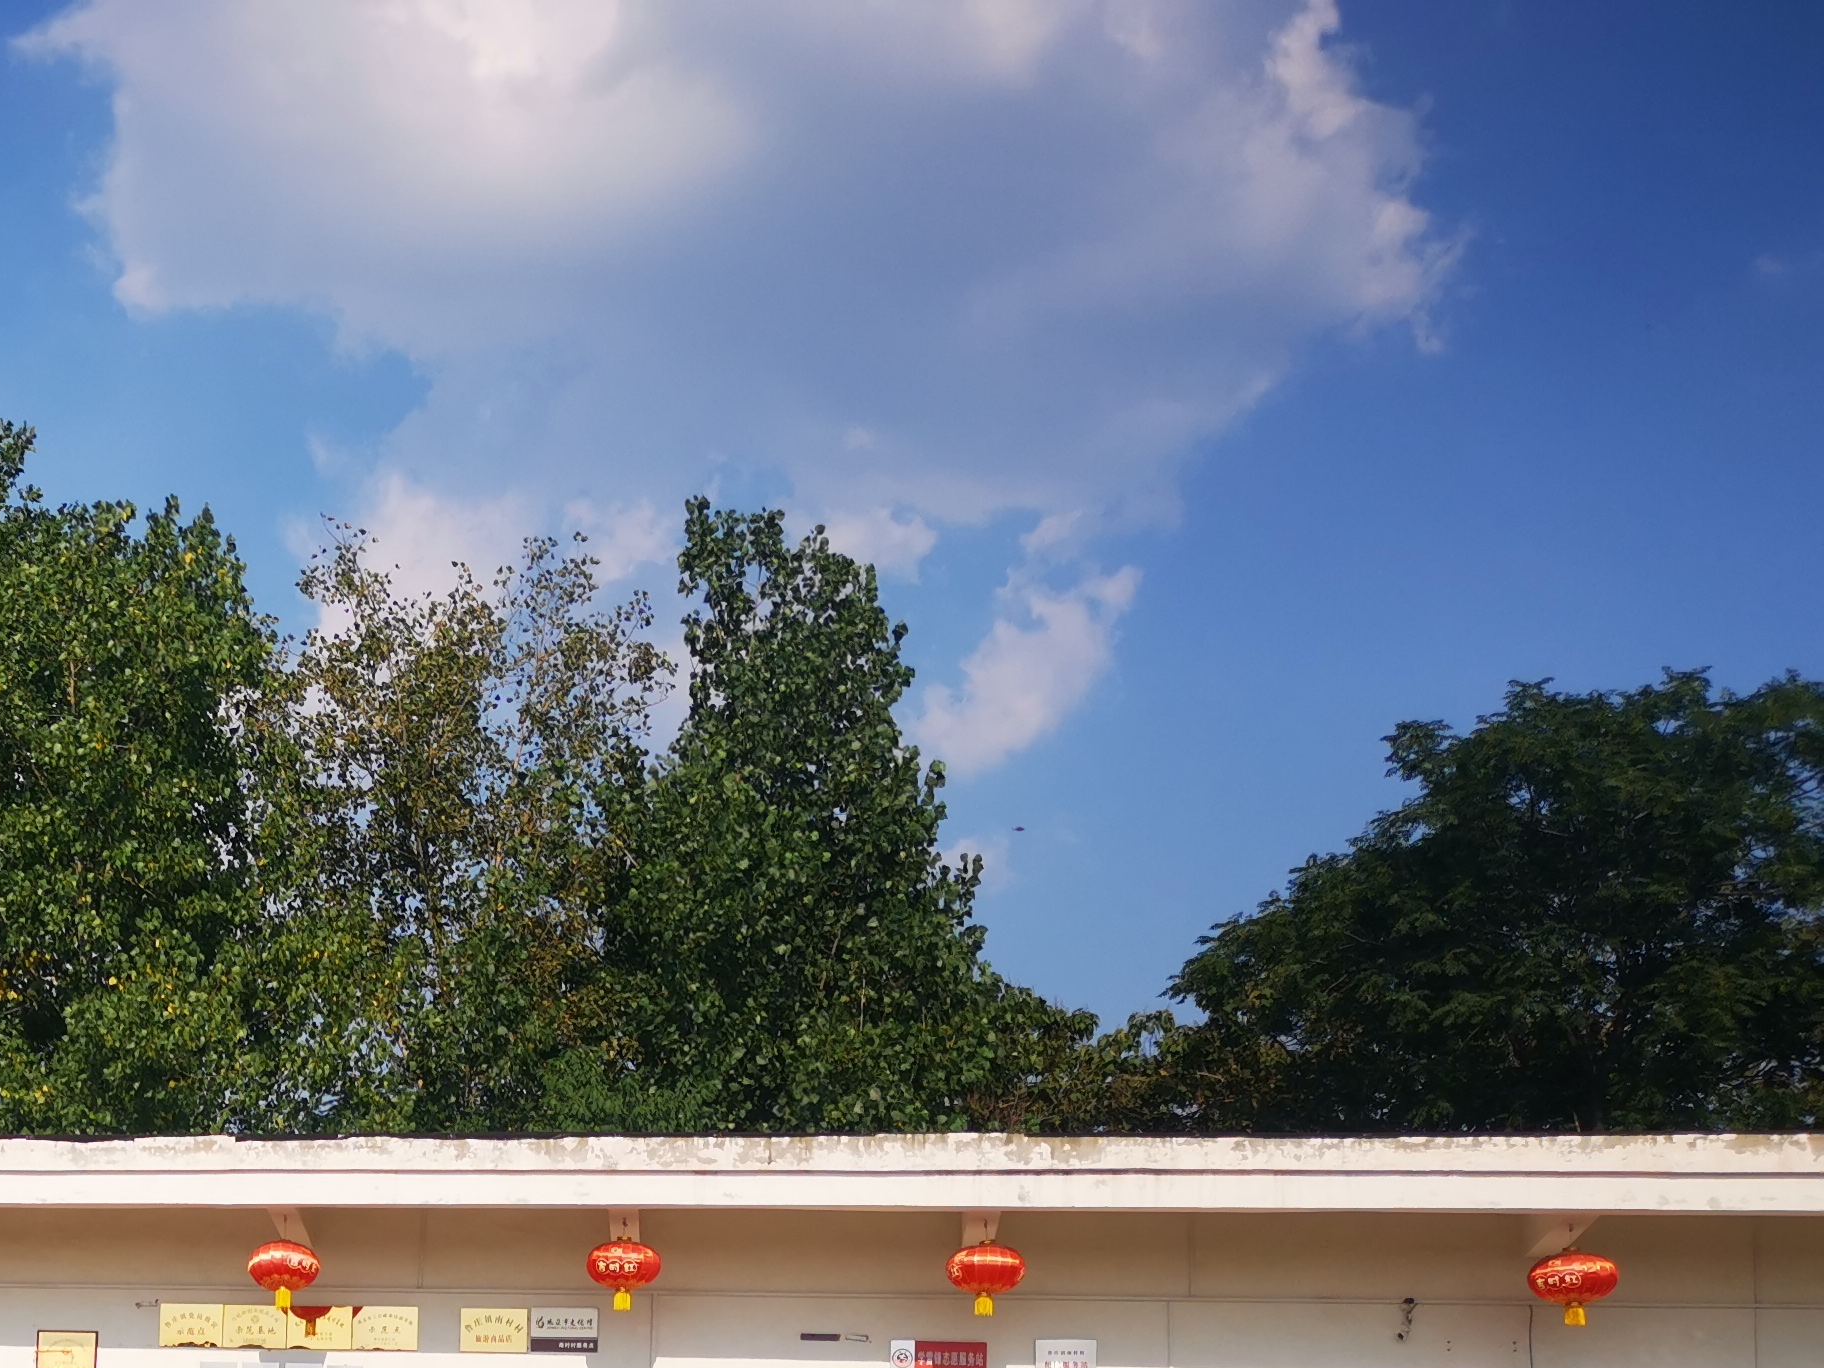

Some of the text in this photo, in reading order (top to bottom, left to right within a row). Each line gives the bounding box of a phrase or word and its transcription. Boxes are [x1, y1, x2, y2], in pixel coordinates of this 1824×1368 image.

[917, 1350, 984, 1367] 学雷锋志愿服务站
